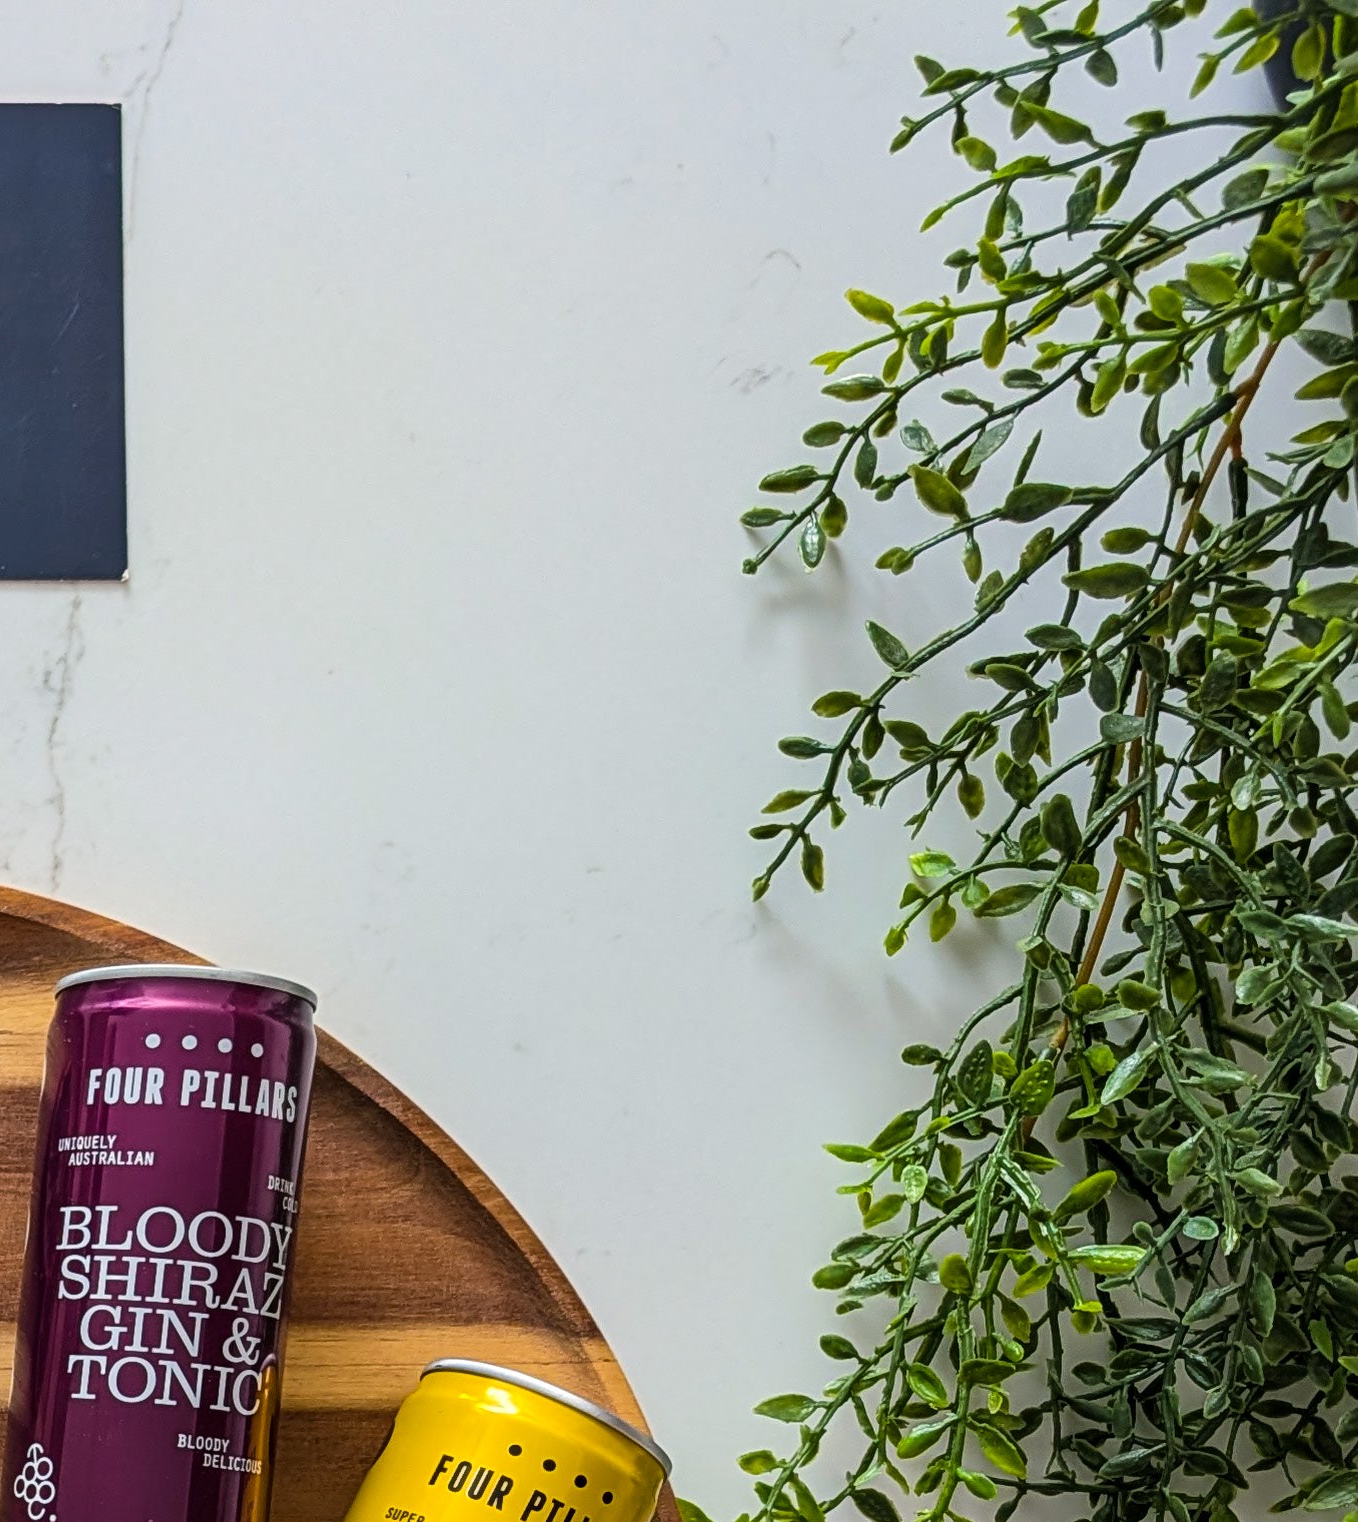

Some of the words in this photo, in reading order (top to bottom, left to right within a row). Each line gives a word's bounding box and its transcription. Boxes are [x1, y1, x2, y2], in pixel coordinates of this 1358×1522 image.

[87, 1067, 164, 1105] FOUR
[180, 1069, 297, 1123] PILLARS
[58, 1135, 117, 1153] UNIQUELY
[68, 1152, 154, 1167] AUSTRALIAN
[56, 1205, 293, 1271] BLOODY
[58, 1255, 285, 1319] SHIRAZ
[80, 1304, 210, 1357] GIN
[222, 1317, 262, 1366] &
[67, 1354, 263, 1416] TONIC
[177, 1434, 230, 1453] BLOODY
[203, 1453, 262, 1475] DELICIOUS
[428, 1454, 514, 1511] FOUR
